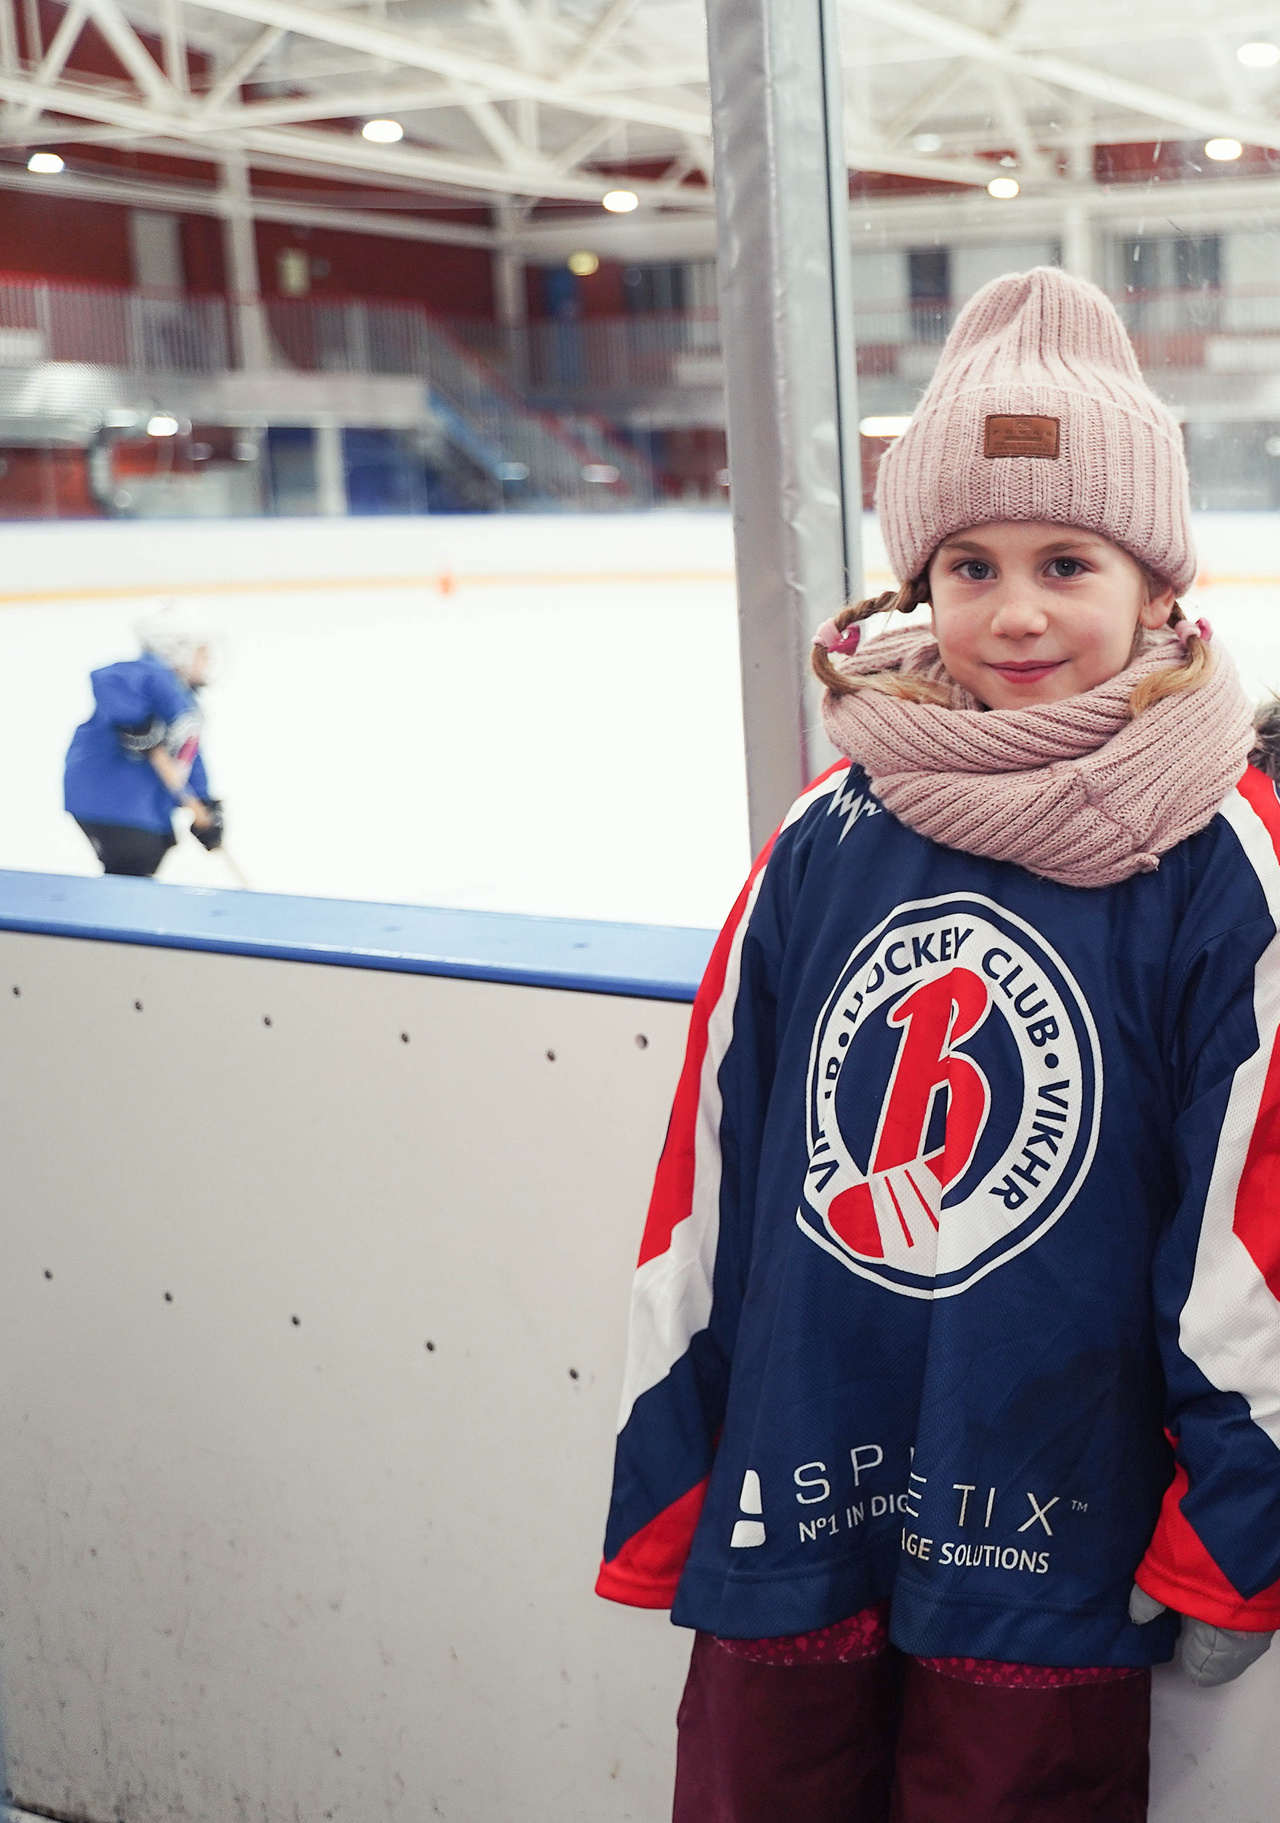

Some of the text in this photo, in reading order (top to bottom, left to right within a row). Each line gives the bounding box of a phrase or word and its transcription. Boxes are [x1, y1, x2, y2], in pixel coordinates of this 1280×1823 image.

[981, 947, 1060, 1048] CLUB
[988, 1078, 1071, 1211] VIKHR
[846, 1501, 865, 1529] IN
[938, 1542, 1051, 1575] SOLUTIONS
